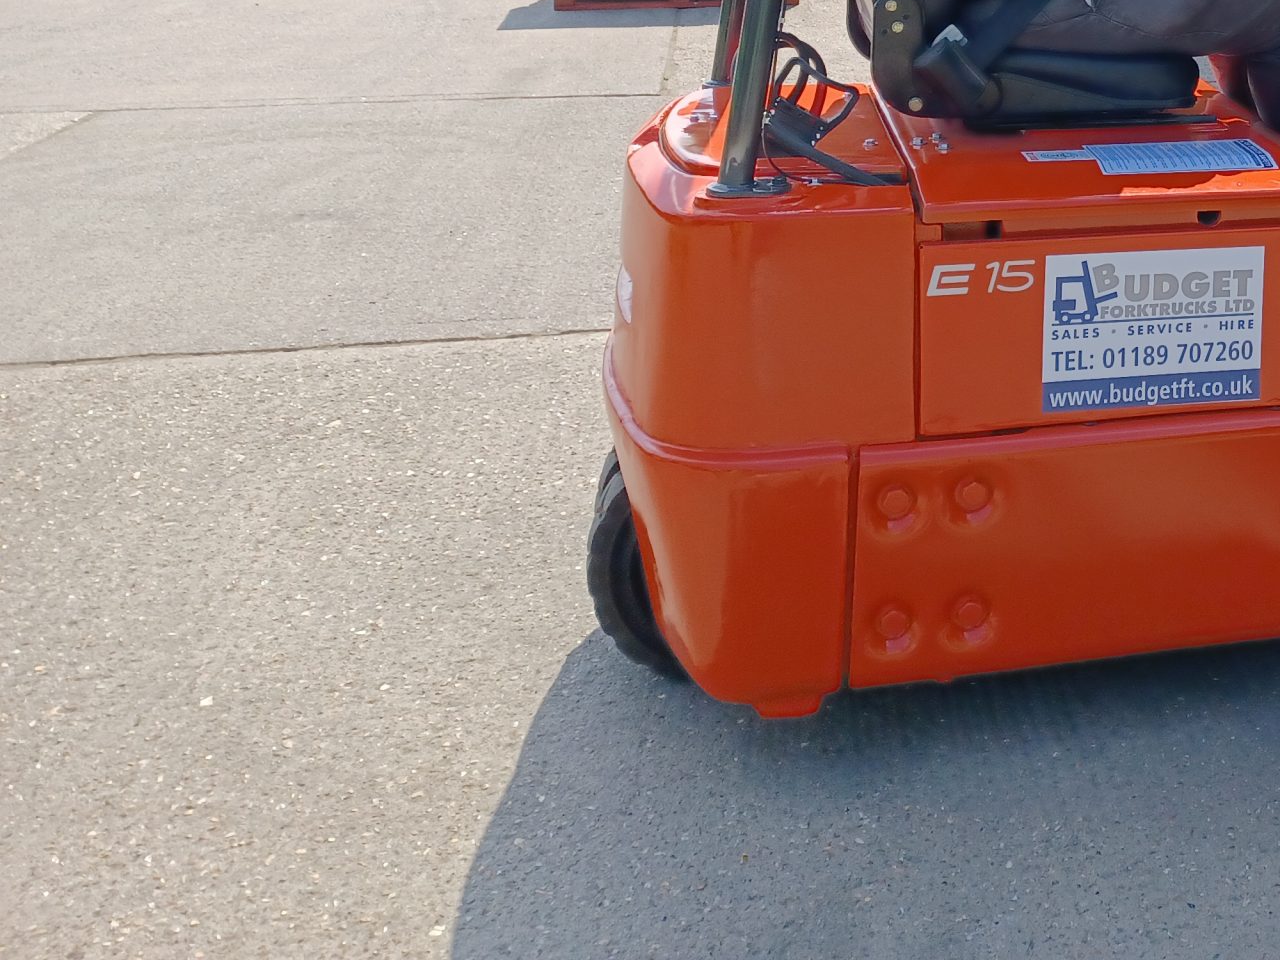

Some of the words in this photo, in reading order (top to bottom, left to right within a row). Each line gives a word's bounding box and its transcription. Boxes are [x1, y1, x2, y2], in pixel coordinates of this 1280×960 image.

[926, 262, 976, 297] E
[985, 259, 1036, 294] 15
[1092, 263, 1254, 303] BUDGET
[1100, 299, 1218, 320] FORKTRUCKS
[1225, 298, 1255, 314] LTD
[1051, 327, 1101, 341] SALES
[1127, 321, 1193, 337] SERVICE
[1218, 318, 1255, 331] HIRE
[1051, 350, 1095, 372] TEL:
[1102, 343, 1169, 369] 01189
[1176, 339, 1254, 365] 707260
[1049, 373, 1254, 406] www.budgetft.co.uk
